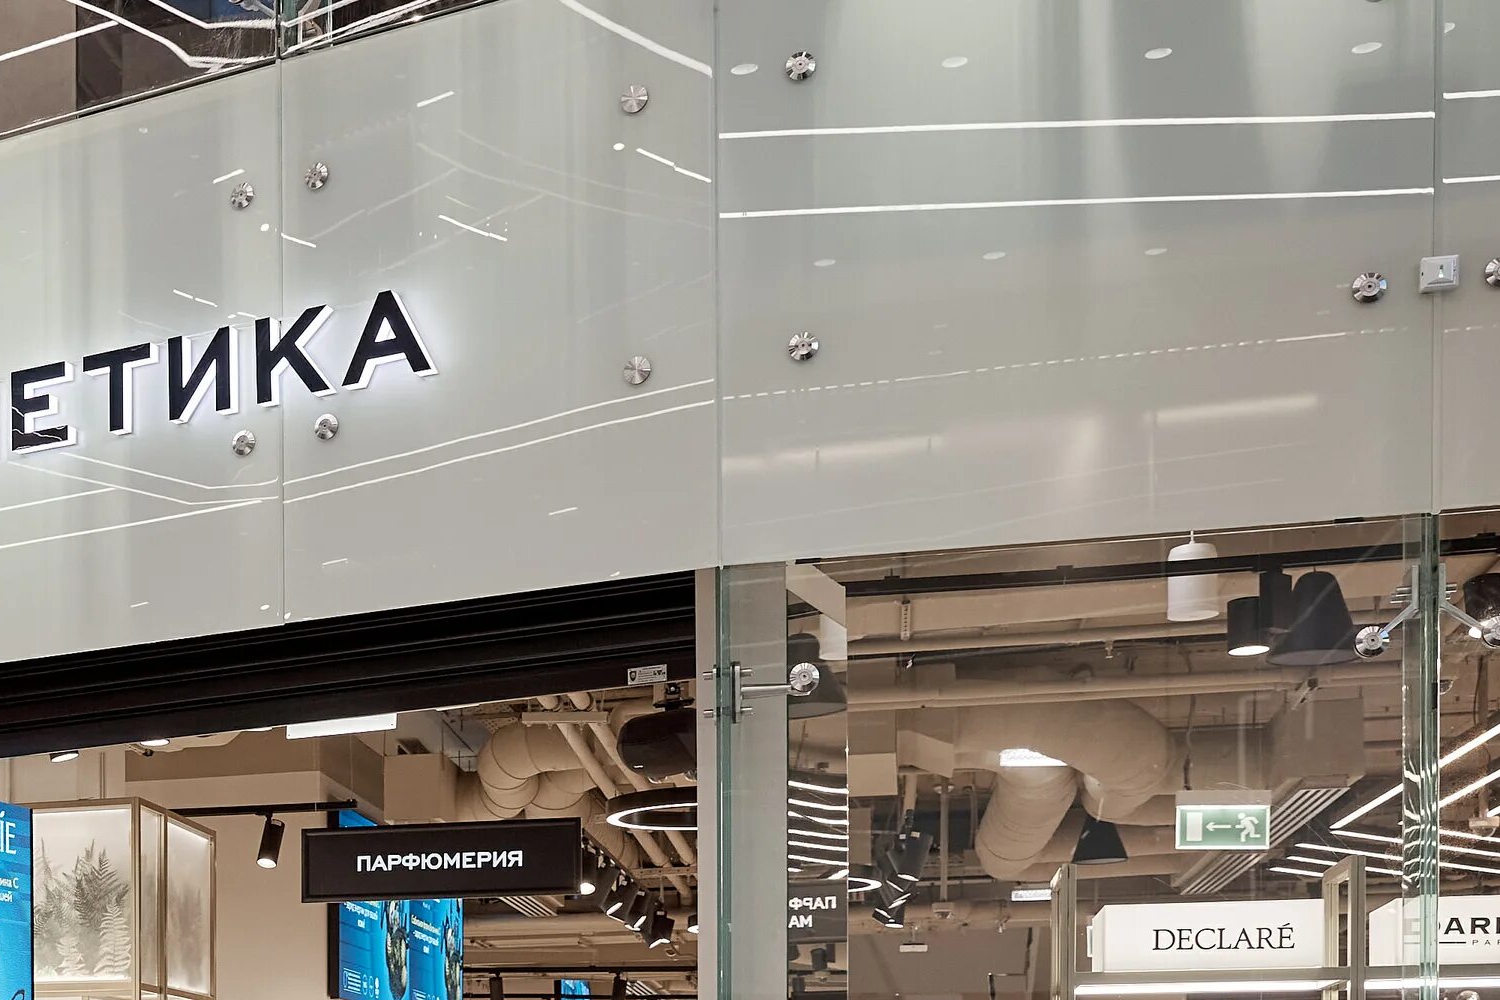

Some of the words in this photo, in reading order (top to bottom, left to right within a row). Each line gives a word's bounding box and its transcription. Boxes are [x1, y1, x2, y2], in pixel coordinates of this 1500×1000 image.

[356, 850, 524, 873] ПАРФЮМЕРИЯ
[1152, 922, 1296, 952] DECLARÉ
[1439, 917, 1500, 935] AR
